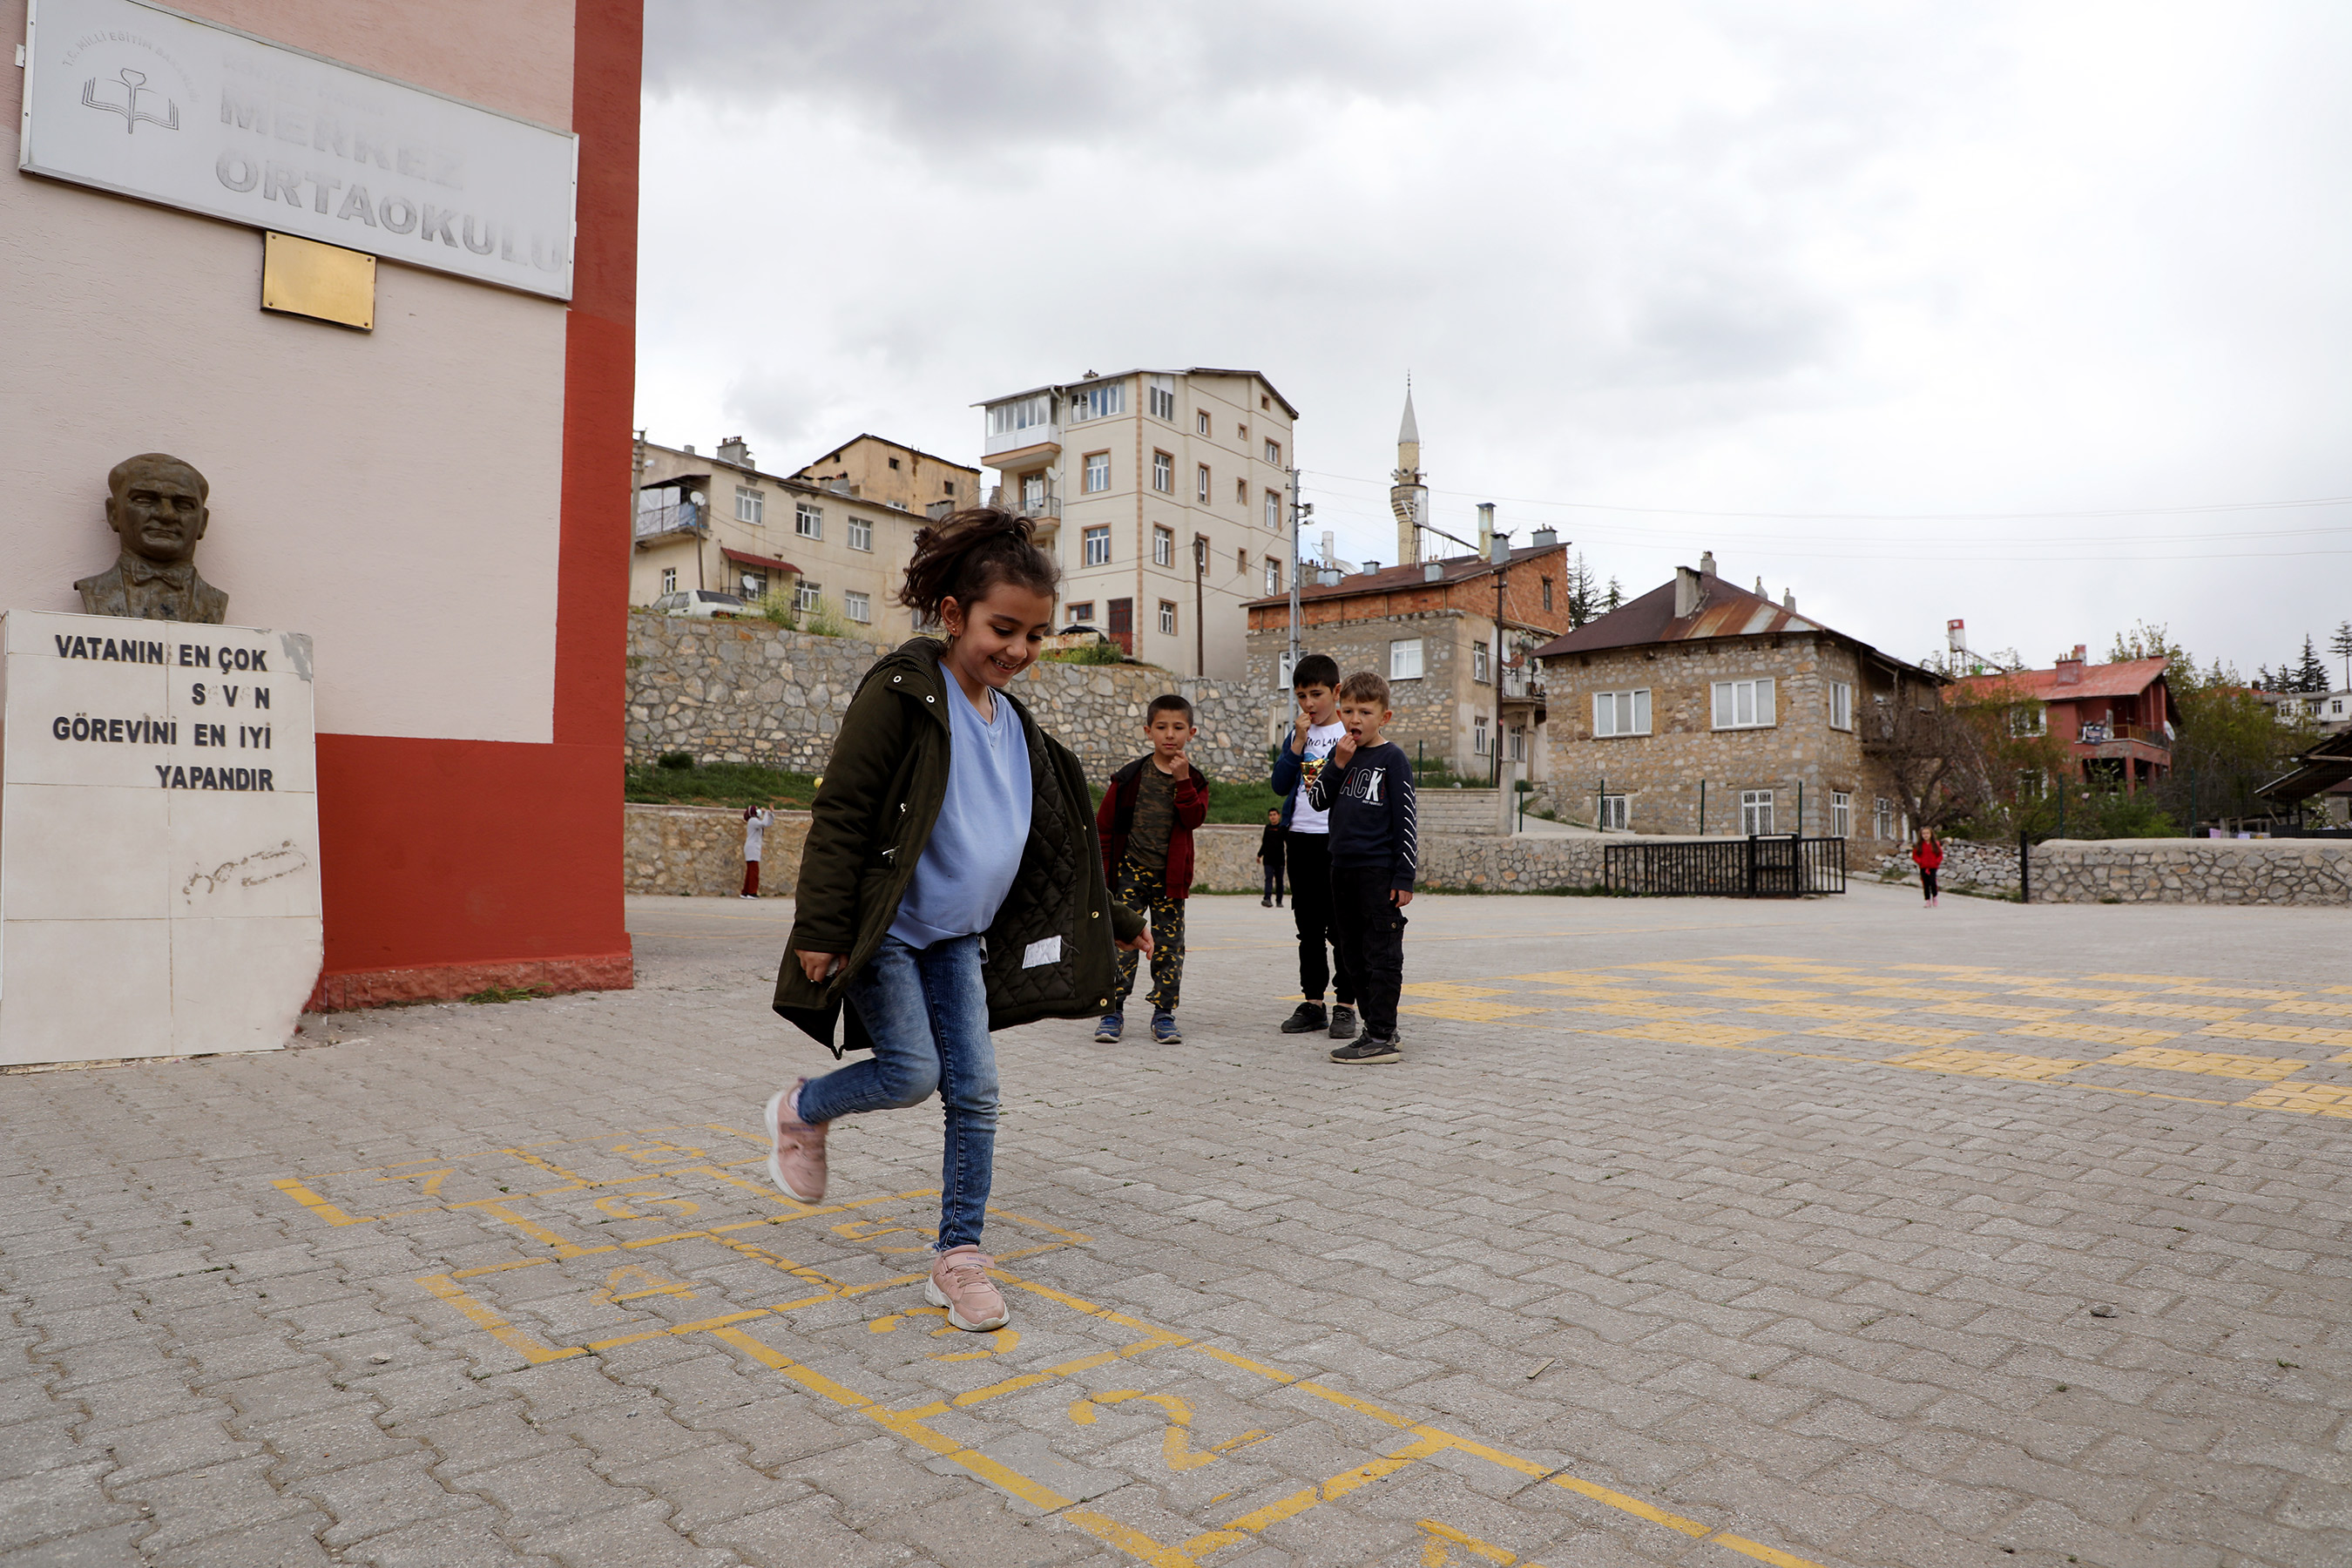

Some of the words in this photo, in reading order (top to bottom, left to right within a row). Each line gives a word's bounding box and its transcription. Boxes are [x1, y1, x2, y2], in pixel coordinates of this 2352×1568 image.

[220, 85, 466, 191] MERKEZ
[215, 147, 564, 273] ORTAOKULU
[55, 634, 164, 665] VATANIN
[179, 644, 210, 667] EN
[218, 646, 268, 674] ÇOK
[52, 713, 177, 745] GÖREVİNİ
[194, 723, 226, 747] EN
[240, 721, 272, 749] İYİ
[155, 764, 274, 791] YAPANDIR
[1068, 1389, 1273, 1470] 2
